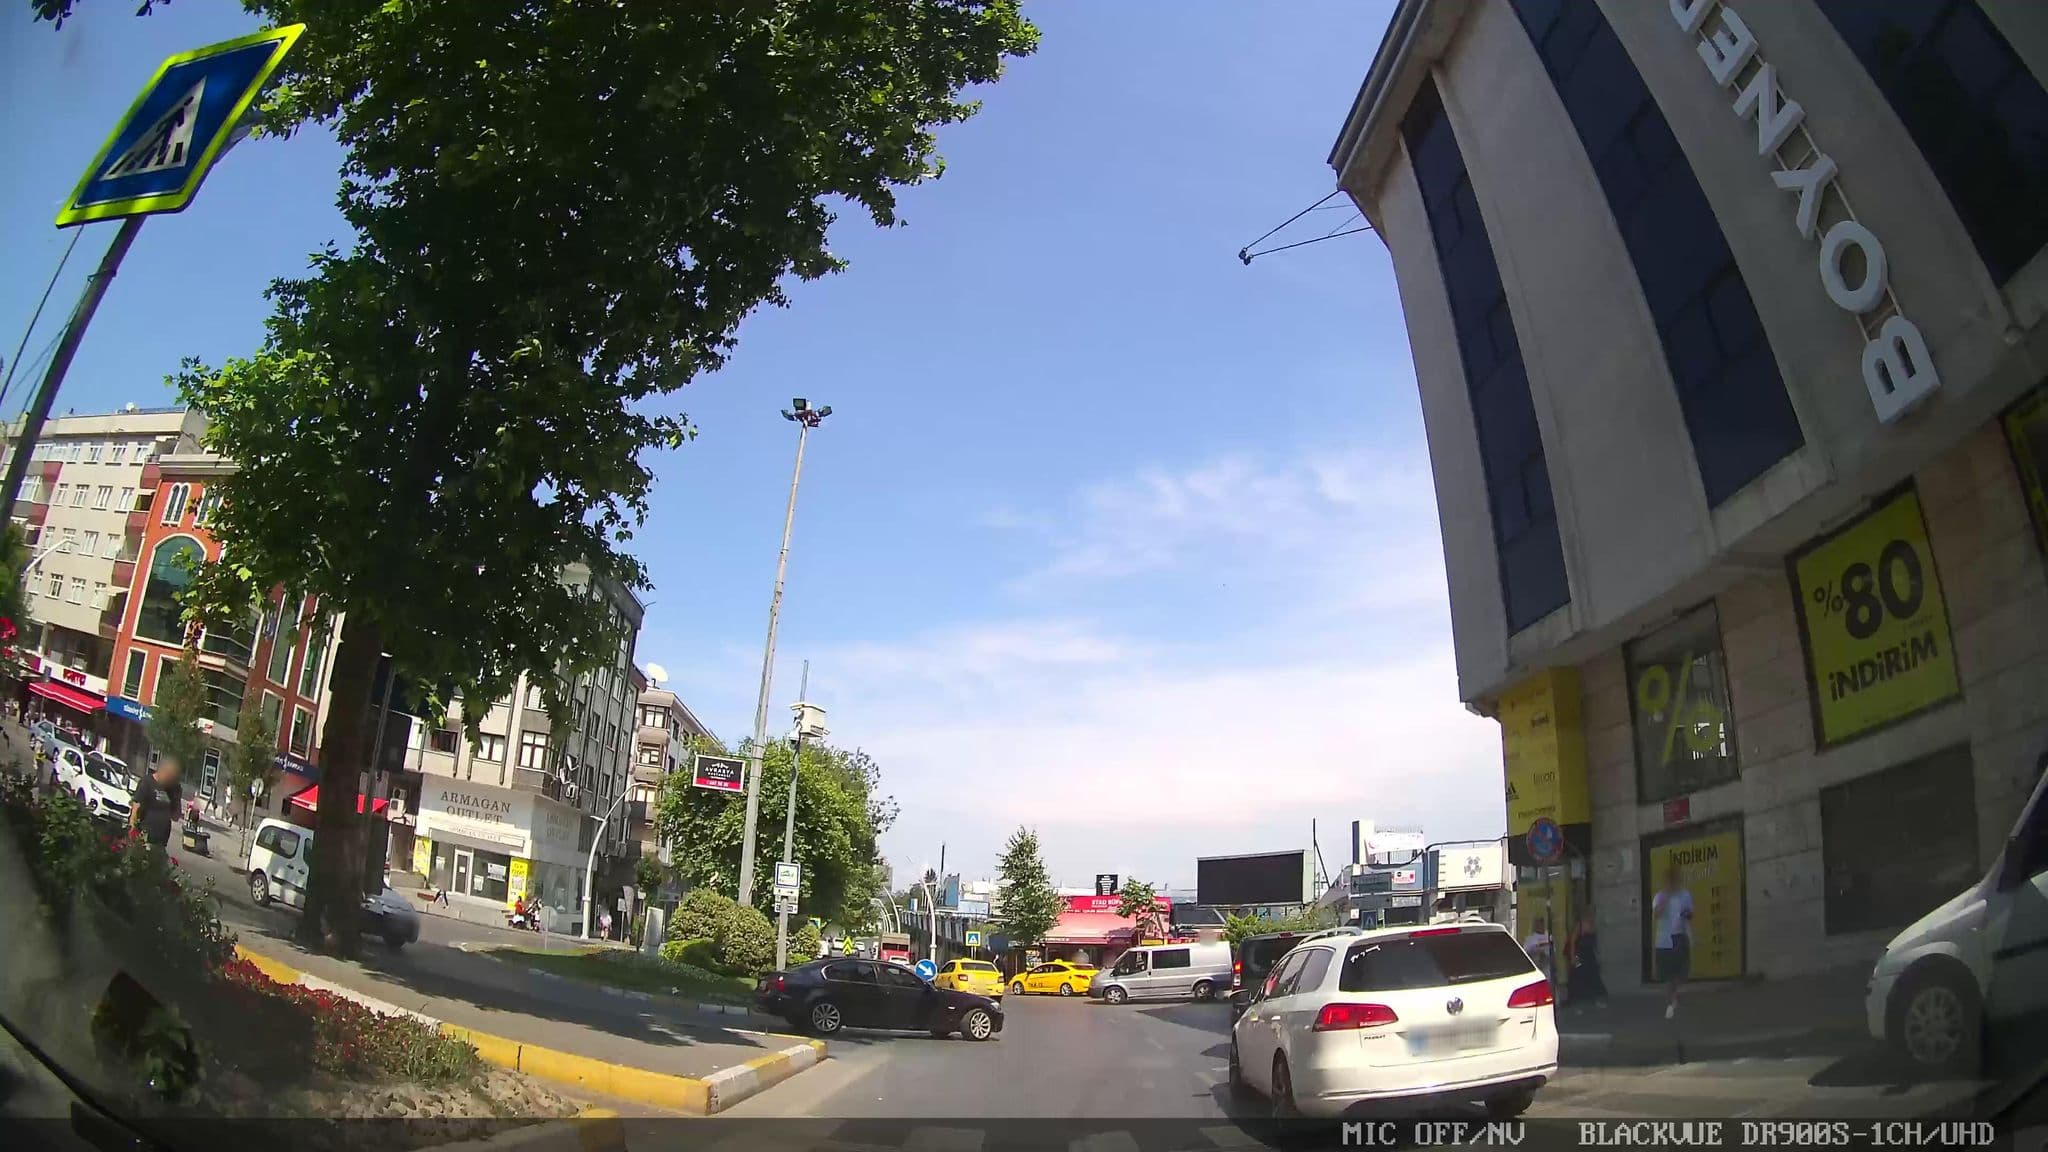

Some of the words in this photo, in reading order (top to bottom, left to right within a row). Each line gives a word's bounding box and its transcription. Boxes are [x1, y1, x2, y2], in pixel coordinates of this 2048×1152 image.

[1813, 538, 1923, 640] %80
[441, 790, 512, 814] ARMAGAN
[446, 805, 504, 824] OUTLET
